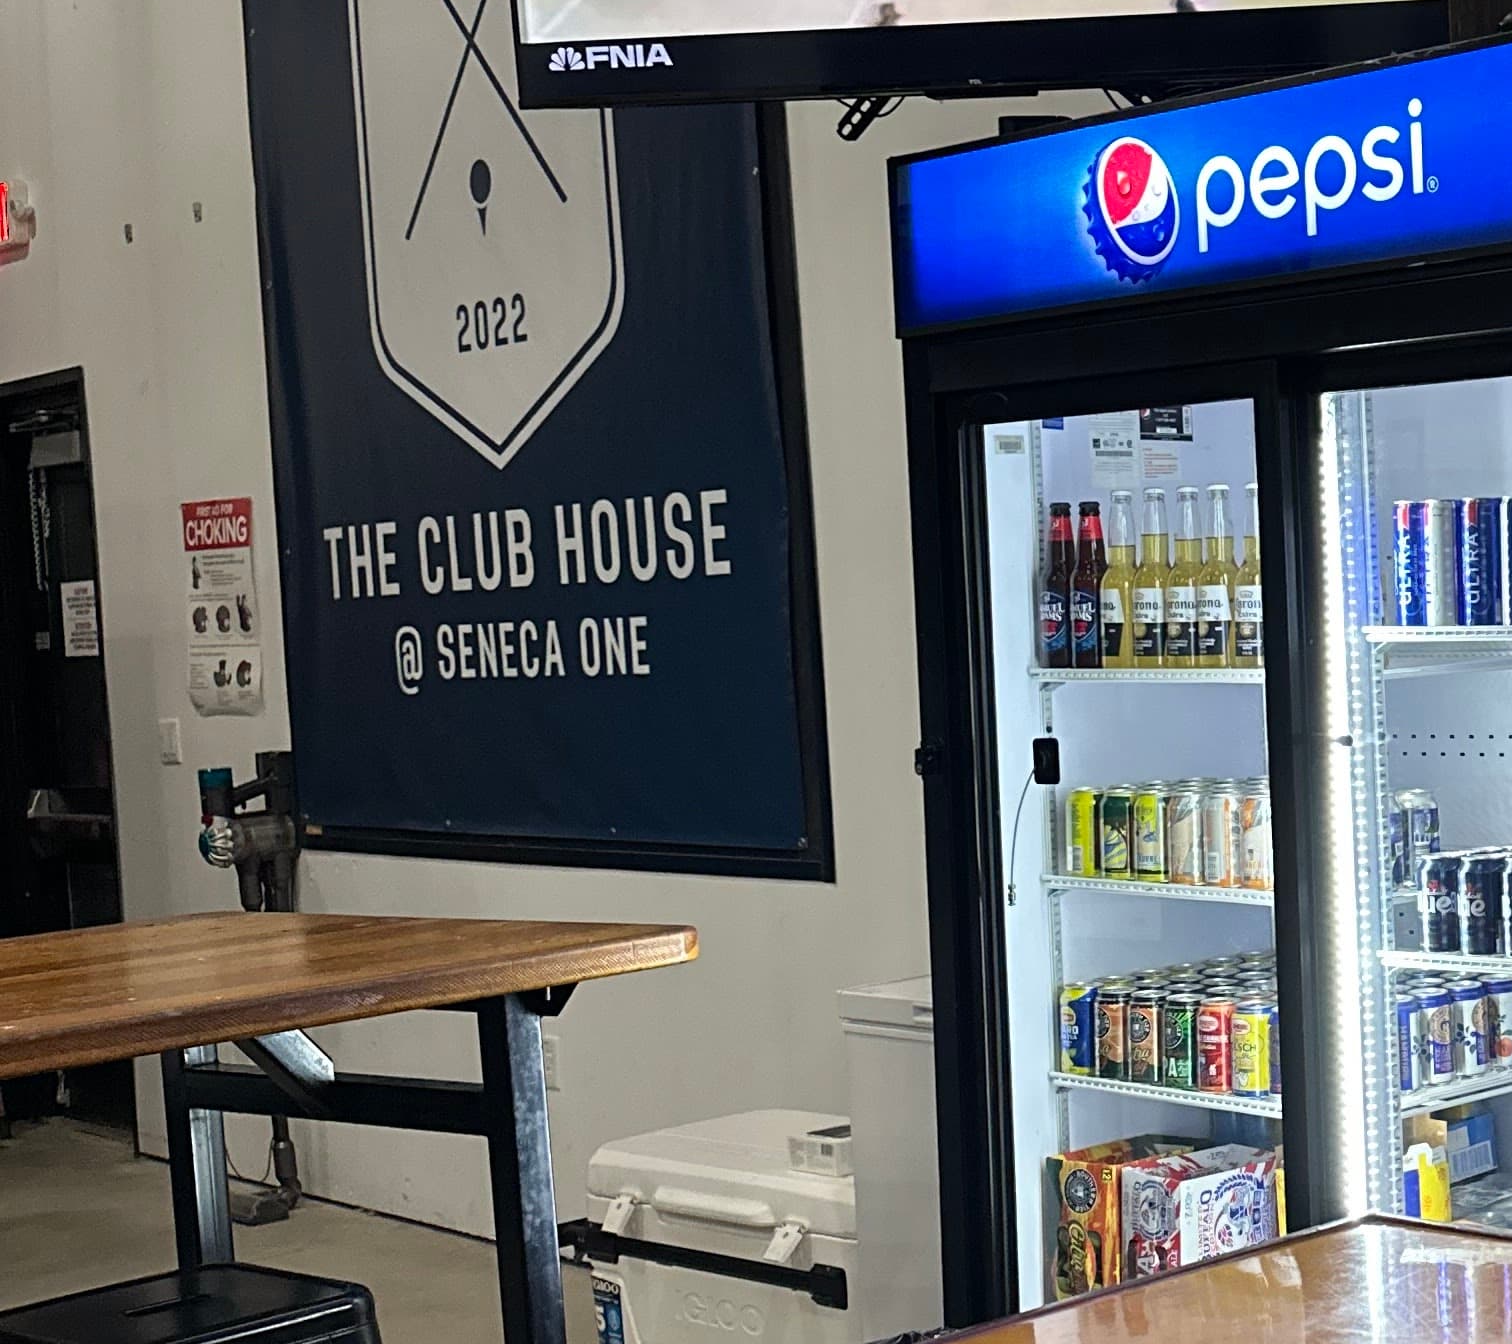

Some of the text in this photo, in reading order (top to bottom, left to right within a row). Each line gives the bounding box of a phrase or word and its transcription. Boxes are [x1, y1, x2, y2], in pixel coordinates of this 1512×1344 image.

[585, 43, 674, 70] FNIA
[1196, 97, 1426, 253] pepsi
[455, 292, 529, 354] 2022
[185, 515, 248, 547] CHOKING
[323, 488, 732, 601] THE CLUB HOUSE
[1465, 532, 1481, 604] ULTRA
[1135, 600, 1159, 611] rona
[1199, 598, 1222, 609] rona
[395, 615, 651, 695] @ SENECA ONE
[593, 1279, 620, 1295] GLOO
